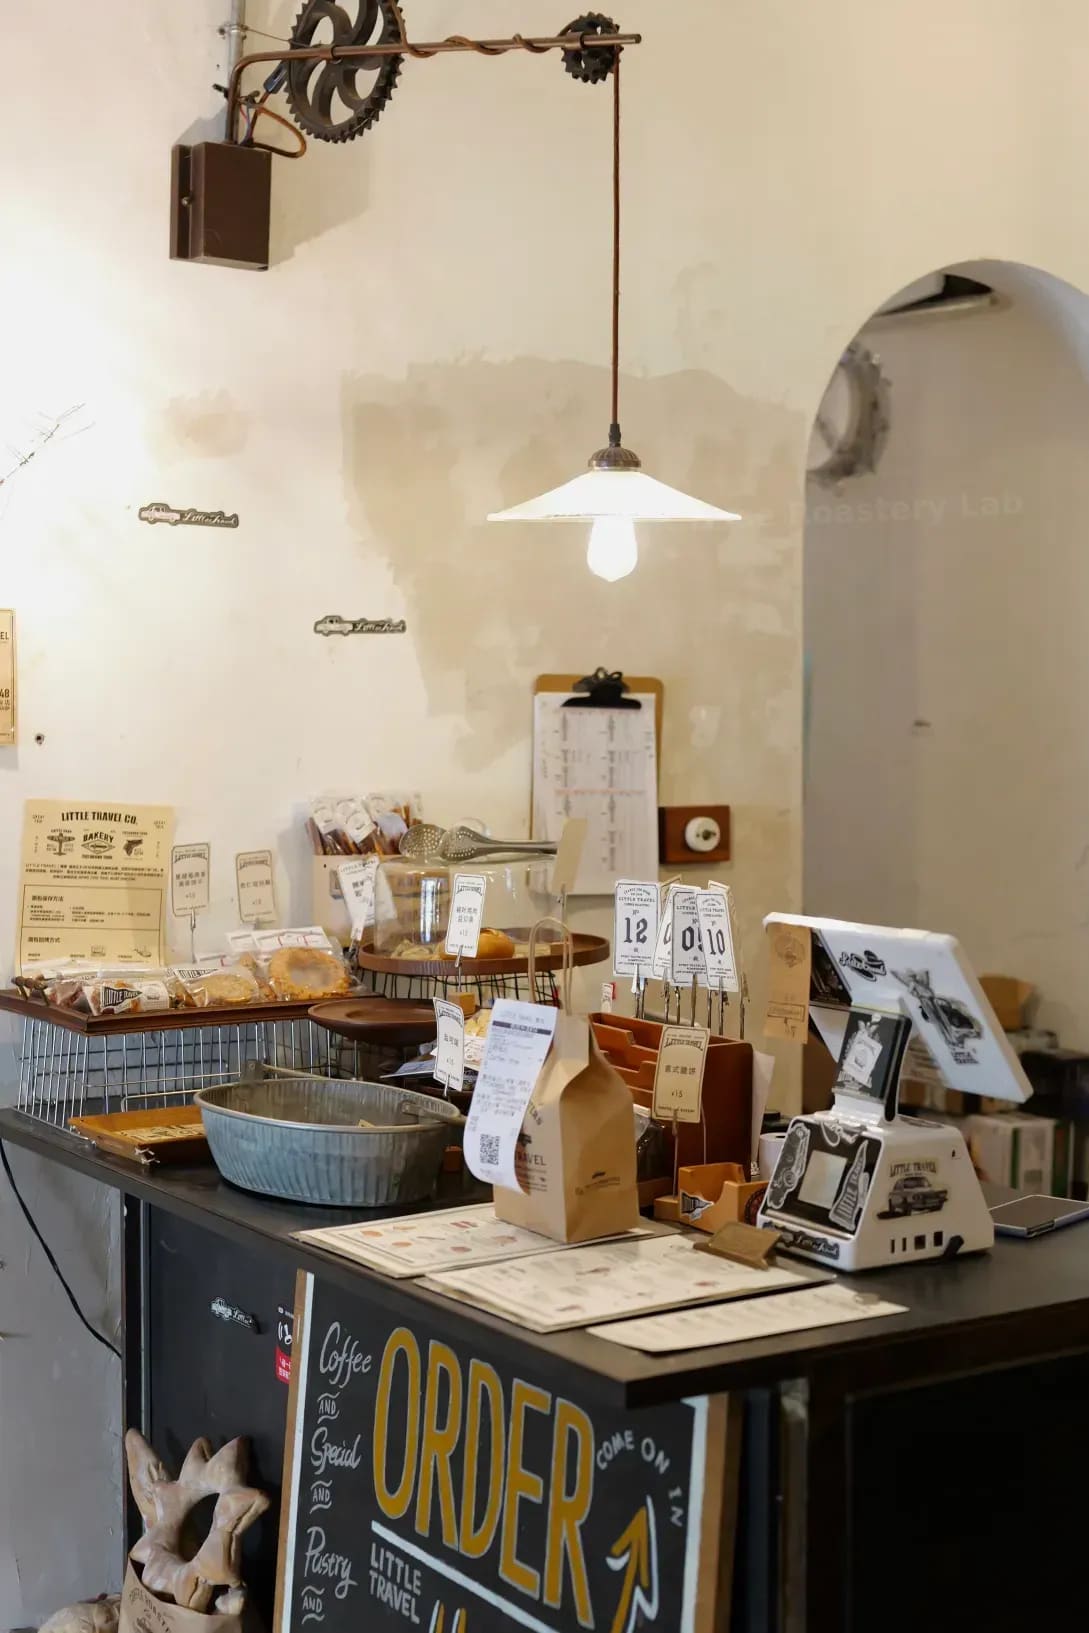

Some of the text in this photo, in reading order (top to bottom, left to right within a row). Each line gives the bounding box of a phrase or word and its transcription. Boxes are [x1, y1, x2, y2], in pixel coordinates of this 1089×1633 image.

[960, 489, 1024, 519] Lab
[61, 811, 89, 822] LITTLE
[92, 811, 122, 823] TRAVEL
[83, 831, 114, 843] BAKERY
[624, 917, 648, 944] 12
[707, 928, 726, 955] 10
[889, 1161, 937, 1177] LITTLE TRAVEL
[319, 1322, 373, 1388] Coffee
[311, 1427, 362, 1476] Special
[372, 1326, 596, 1630] ORDER
[596, 1429, 684, 1528] COME ON IN
[304, 1526, 359, 1600] Pastry
[370, 1543, 422, 1597] LITTLE
[369, 1573, 422, 1626] TRAVEL
